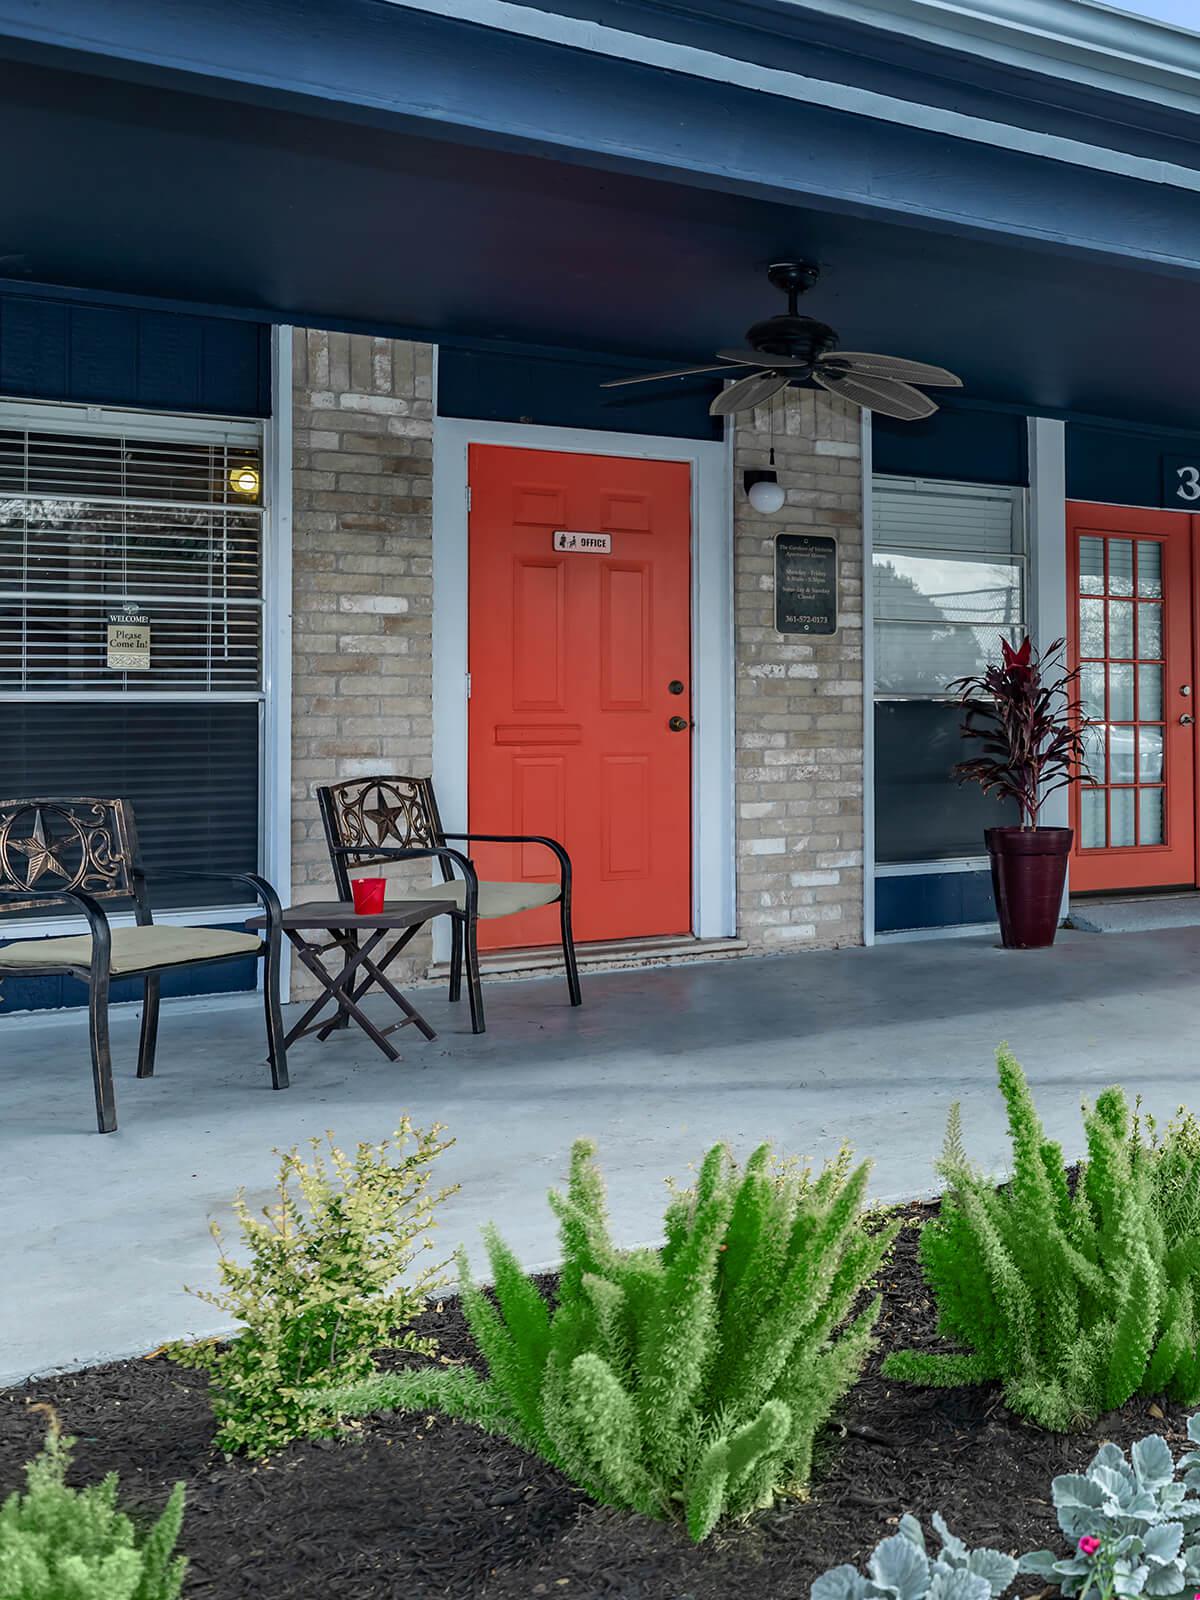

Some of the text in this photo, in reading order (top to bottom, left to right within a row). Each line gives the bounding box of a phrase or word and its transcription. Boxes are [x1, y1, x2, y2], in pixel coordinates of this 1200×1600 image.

[580, 537, 607, 548] OFFICE
[785, 615, 829, 624] 361-572-0173
[115, 630, 142, 640] Please
[110, 639, 148, 649] Come In!
